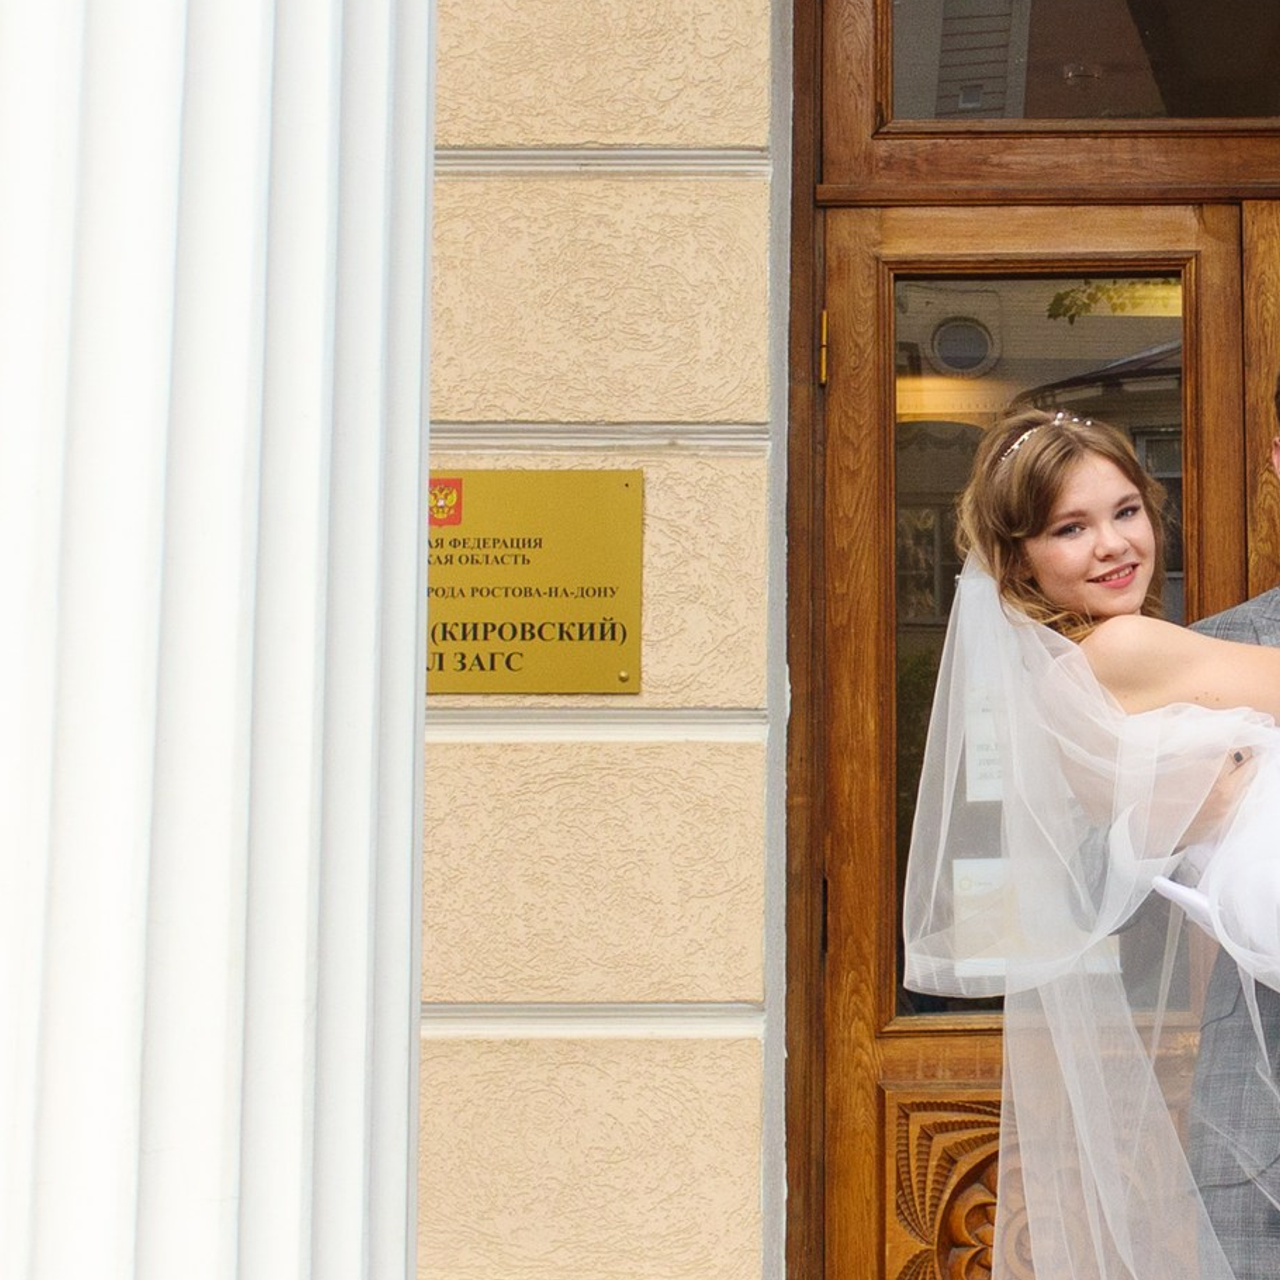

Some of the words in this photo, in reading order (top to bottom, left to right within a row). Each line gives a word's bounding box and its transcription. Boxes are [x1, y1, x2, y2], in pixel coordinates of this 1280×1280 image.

[448, 538, 543, 550] ФЕДЕРАЦИЯ
[458, 553, 531, 566] ОБЛАСТЬ
[470, 586, 620, 600] РОСТОВА-НА-ДОНУ
[430, 616, 628, 647] (КИРОВСКИЙ)
[452, 651, 524, 672] ЗАГС
